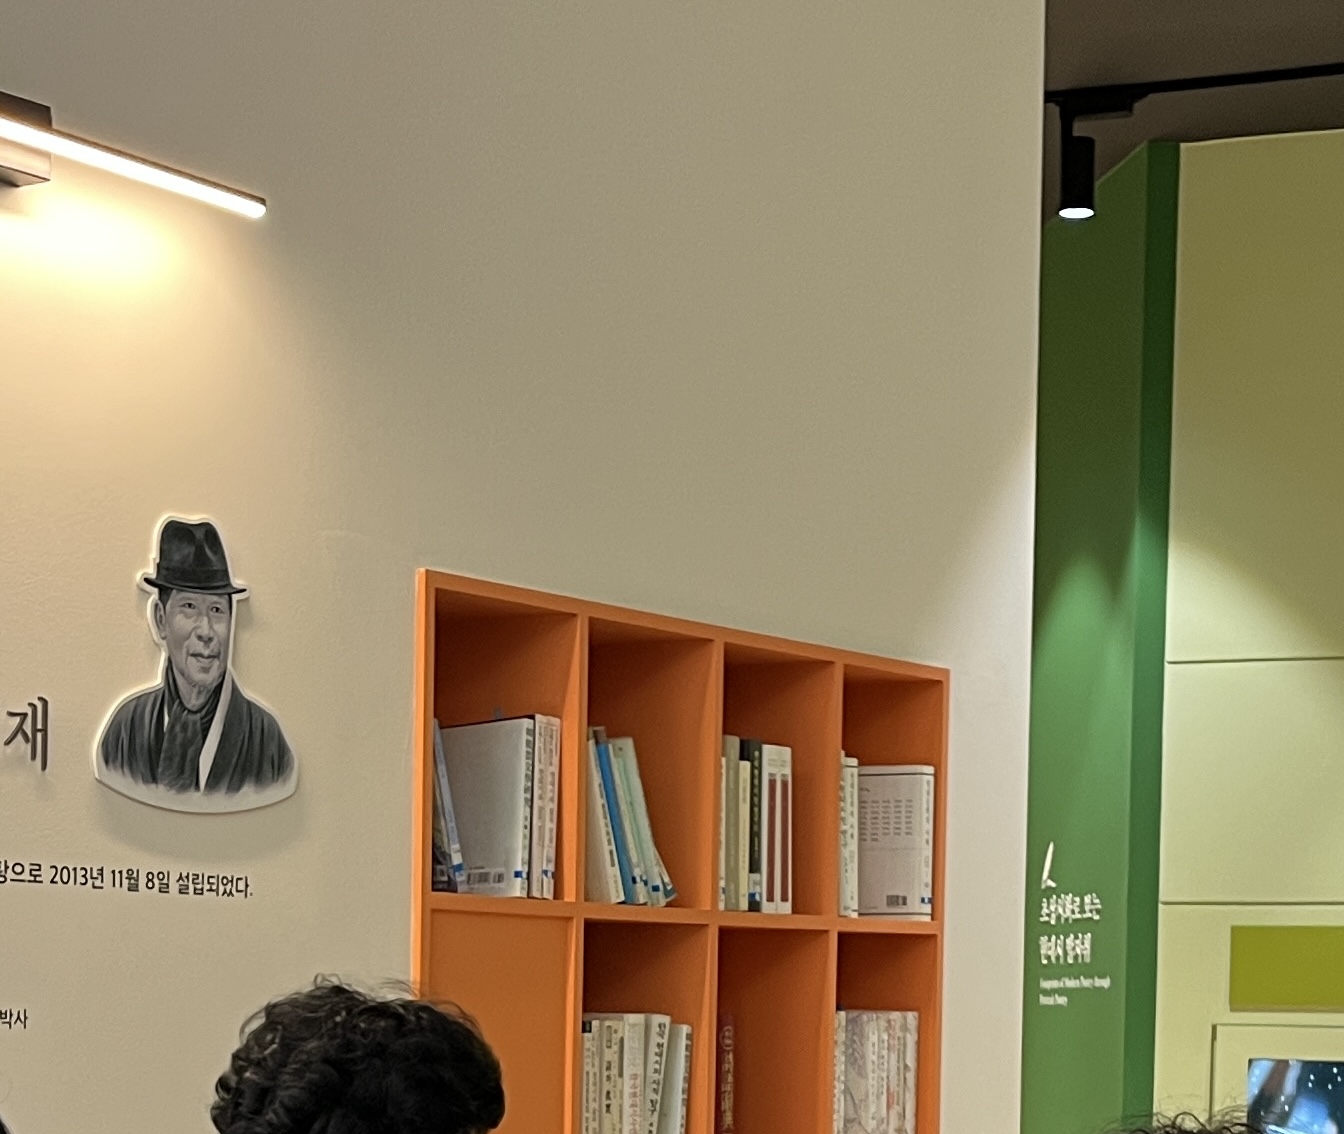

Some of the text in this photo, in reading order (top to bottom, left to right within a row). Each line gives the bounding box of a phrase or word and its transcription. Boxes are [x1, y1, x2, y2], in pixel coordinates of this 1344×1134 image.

[49, 864, 105, 890] 2013년
[110, 868, 141, 893] 11월
[145, 871, 172, 894] 8일
[175, 871, 255, 900] 설립되었다.
